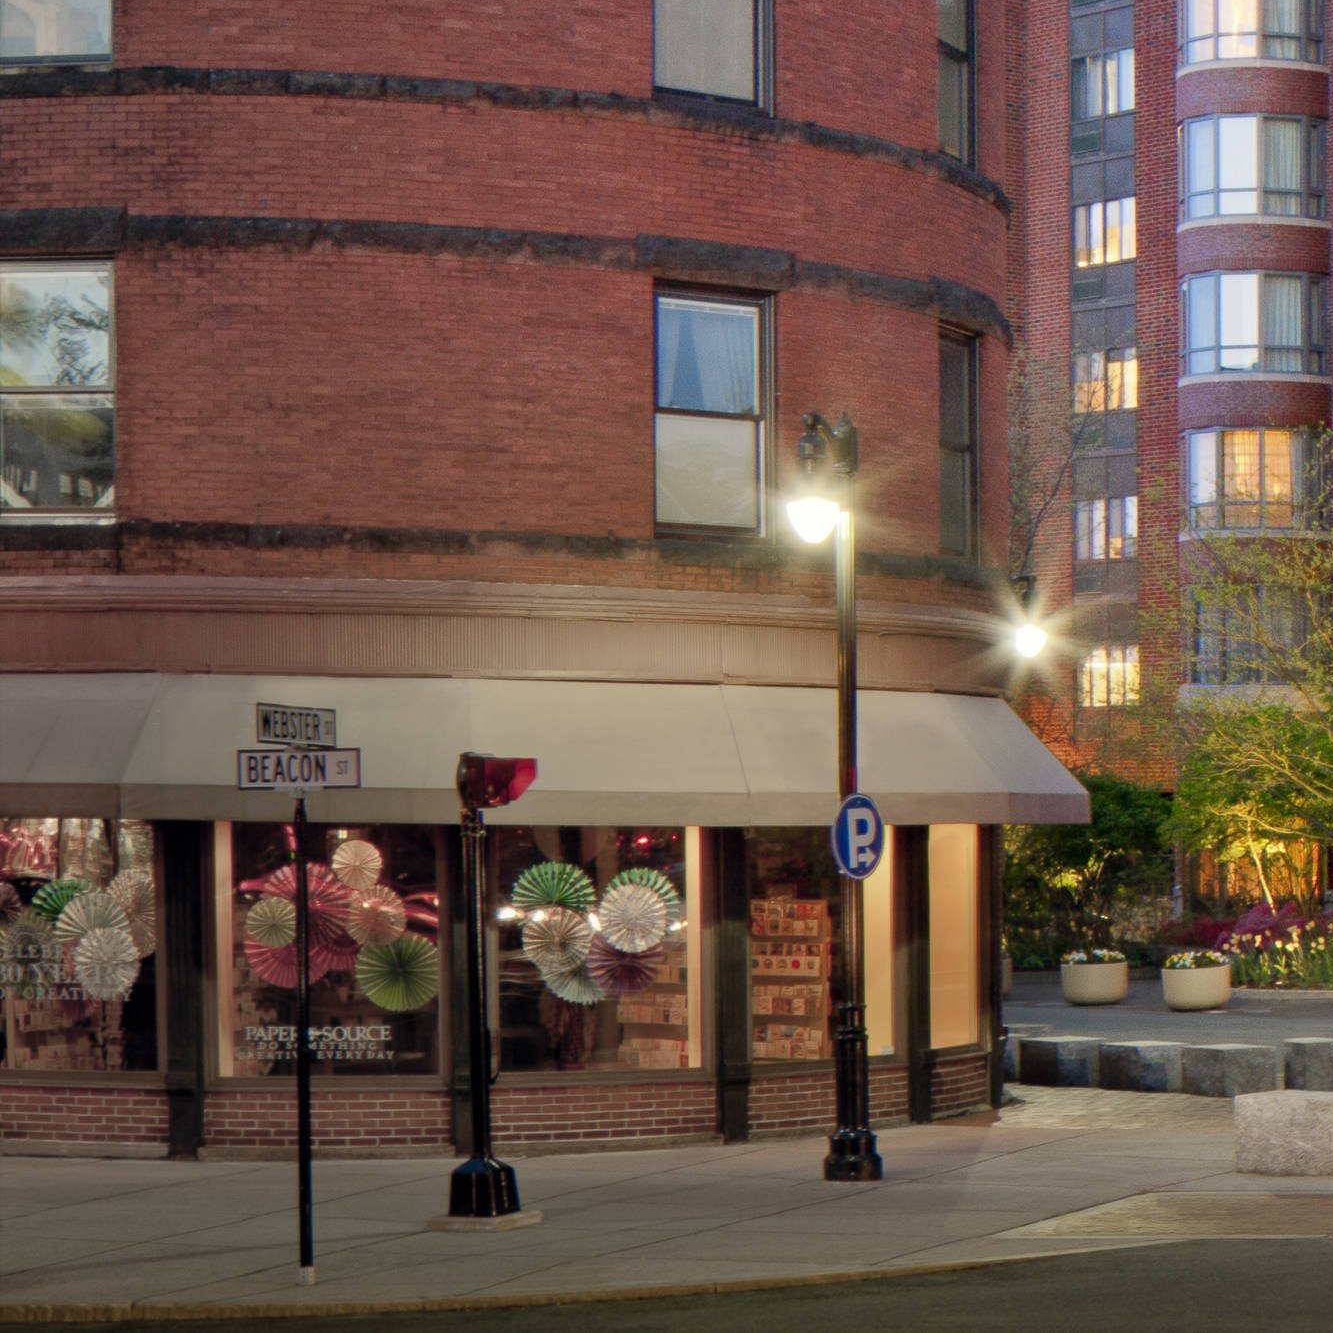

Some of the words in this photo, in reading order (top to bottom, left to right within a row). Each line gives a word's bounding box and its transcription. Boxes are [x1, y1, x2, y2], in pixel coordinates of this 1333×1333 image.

[261, 709, 321, 741] WEBSTER
[247, 754, 327, 783] BEACON
[336, 760, 348, 775] ST
[847, 807, 877, 869] P
[322, 1025, 392, 1041] SOURCE
